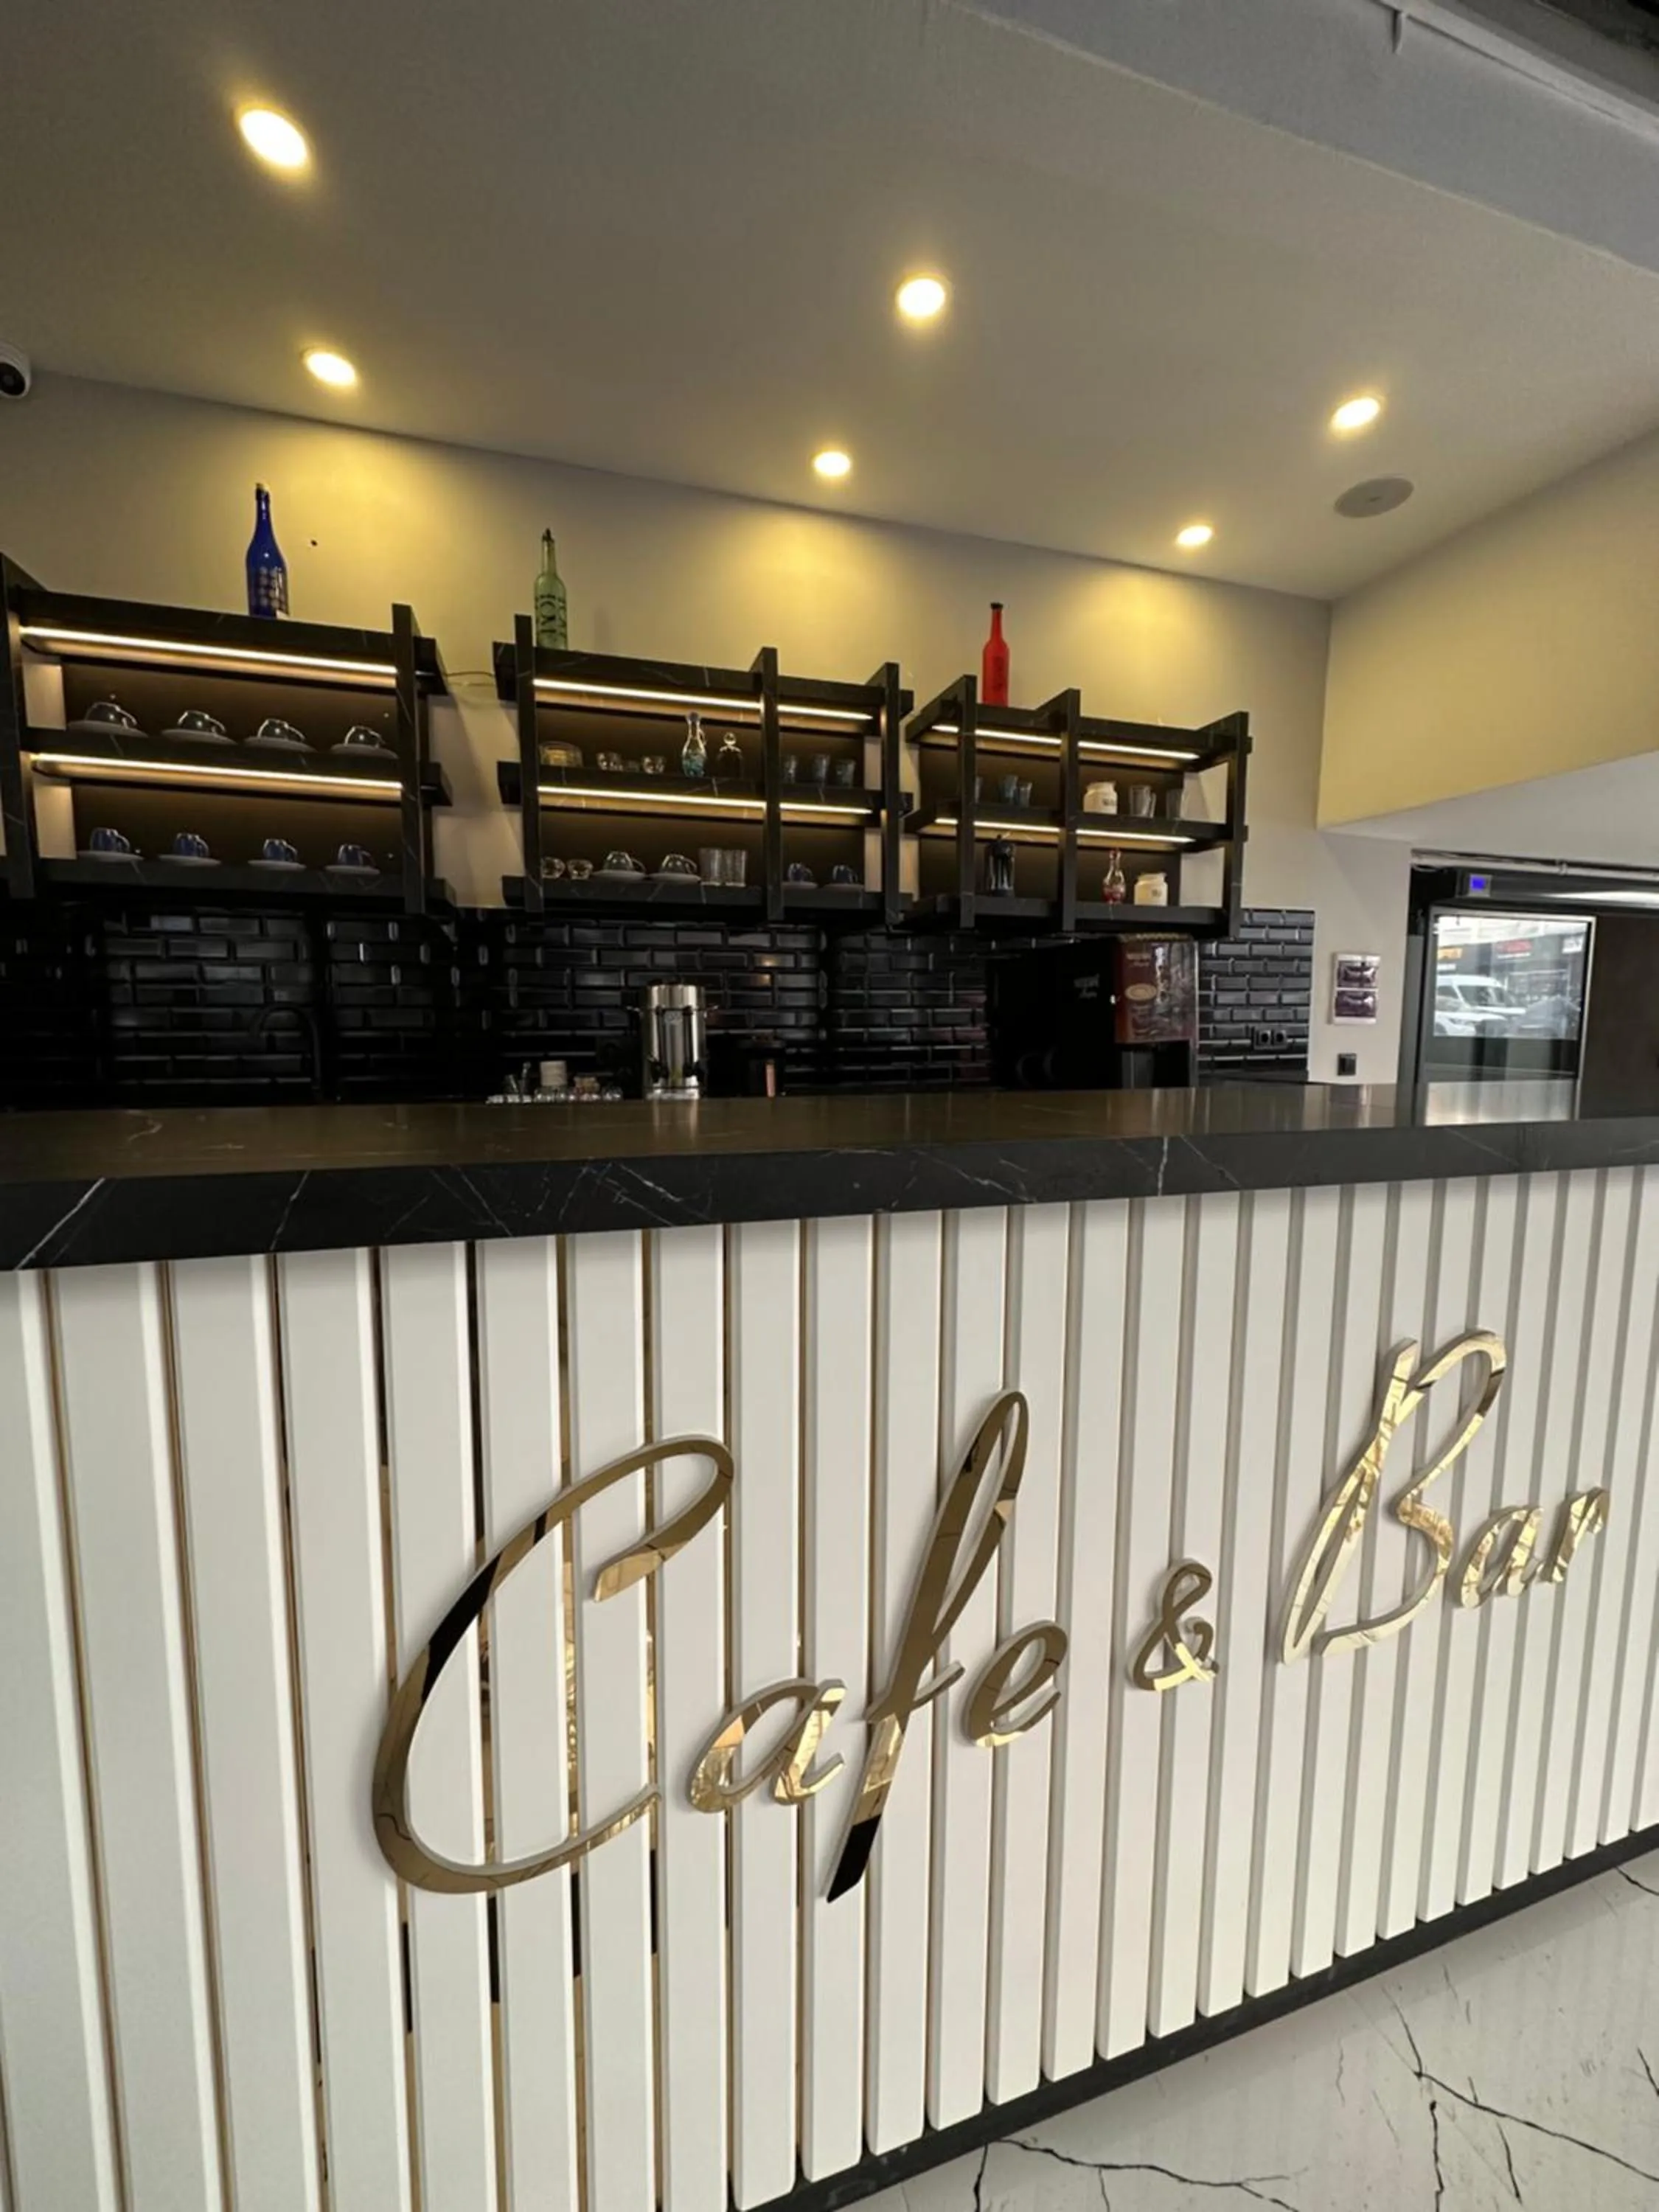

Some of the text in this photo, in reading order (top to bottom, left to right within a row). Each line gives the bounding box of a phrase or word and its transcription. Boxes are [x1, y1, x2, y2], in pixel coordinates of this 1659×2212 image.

[372, 1329, 1608, 1902] Cafe & Bar
